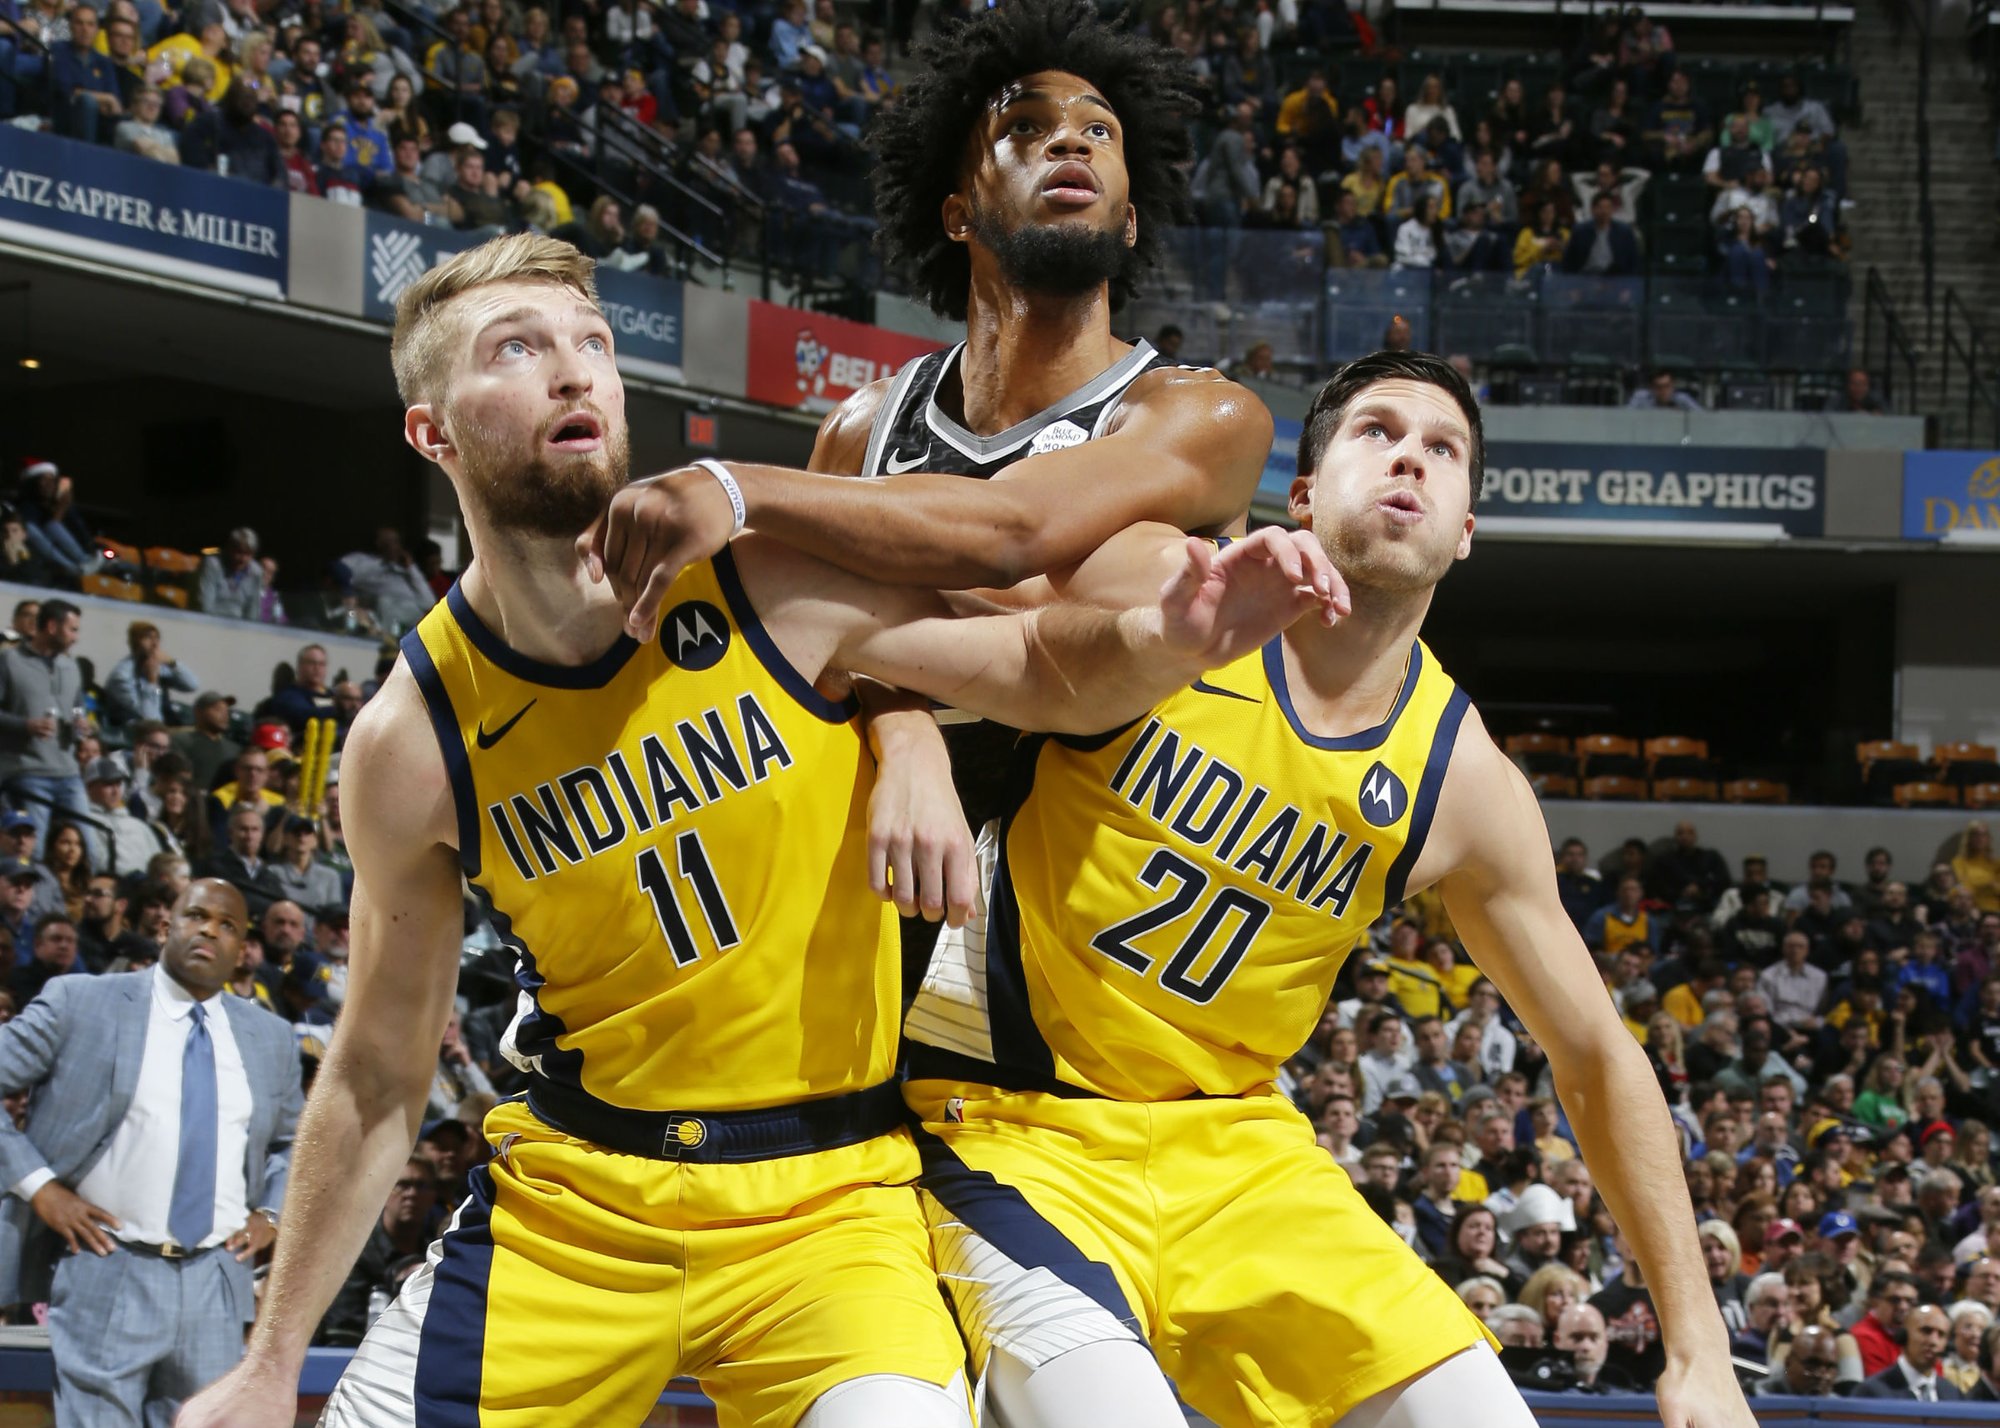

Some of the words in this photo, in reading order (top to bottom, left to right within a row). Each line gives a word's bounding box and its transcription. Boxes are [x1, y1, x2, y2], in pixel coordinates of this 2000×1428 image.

[0, 166, 52, 208] ATZ
[57, 180, 154, 232] SAPPER
[158, 207, 177, 236] &
[182, 209, 279, 258] MILLER
[1596, 470, 1816, 511] GRAPHICS
[488, 690, 795, 882] INDIANA
[1107, 715, 1375, 920] INDIANA
[635, 828, 742, 969] 11
[1087, 845, 1274, 1006] 20
